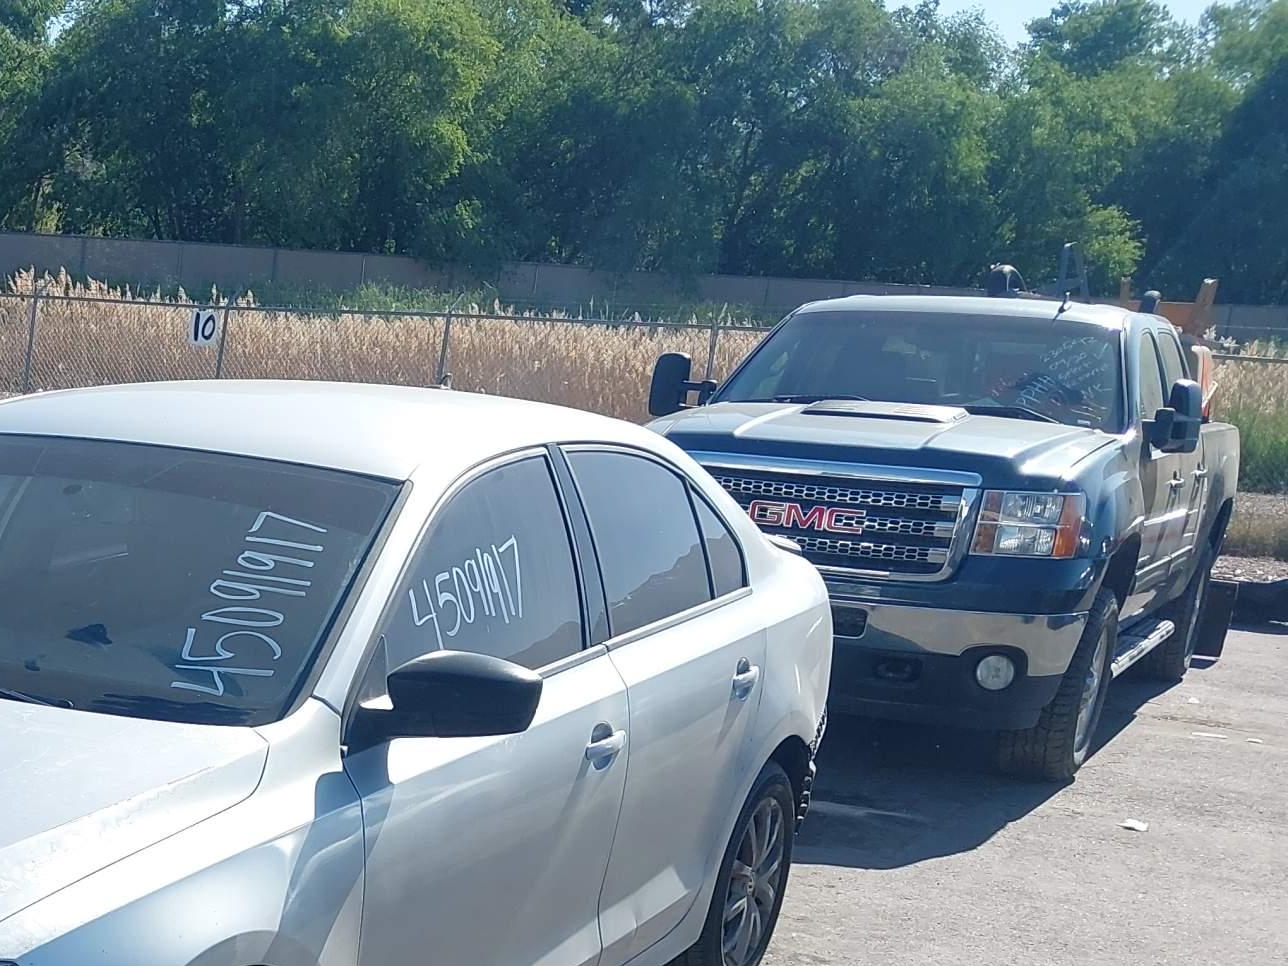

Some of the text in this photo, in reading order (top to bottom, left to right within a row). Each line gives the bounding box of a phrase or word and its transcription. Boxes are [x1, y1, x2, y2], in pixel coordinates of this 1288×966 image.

[193, 311, 216, 342] 10
[749, 499, 867, 535] GMC
[170, 511, 328, 696] 45091917
[408, 534, 523, 650] 45091917
